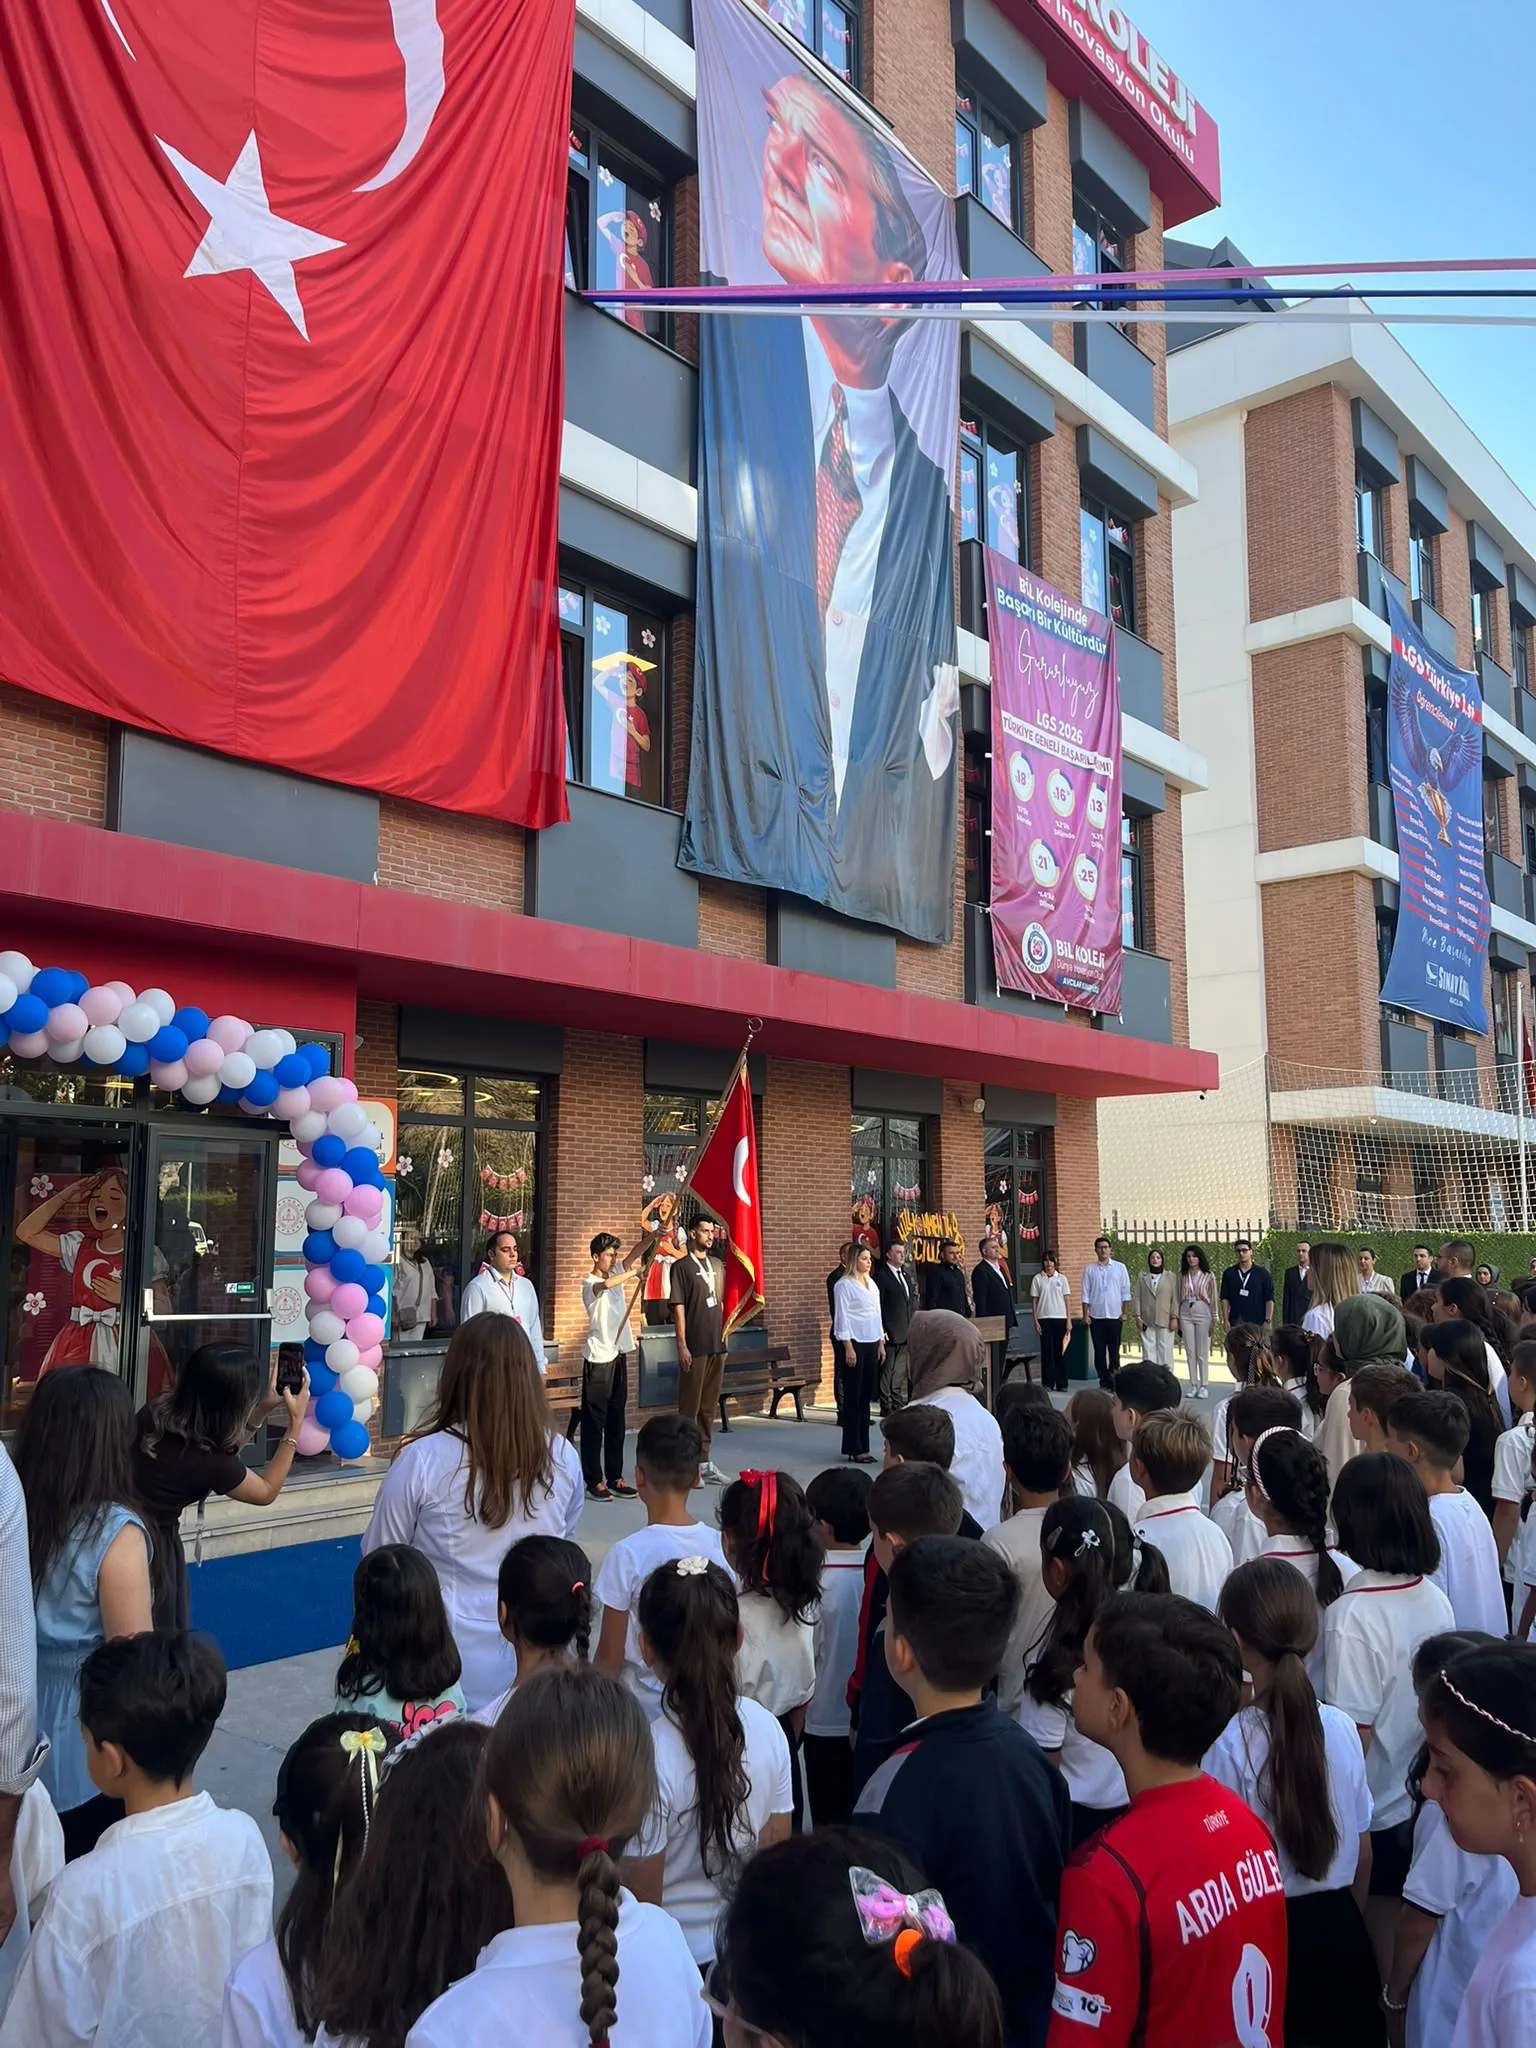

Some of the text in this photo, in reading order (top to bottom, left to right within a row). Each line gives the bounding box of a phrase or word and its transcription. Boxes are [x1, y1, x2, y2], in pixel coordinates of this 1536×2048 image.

[1071, 0, 1197, 138] OLEJİ
[1150, 103, 1195, 164] Okulu
[997, 588, 1107, 654] Başarı Bir Kültürdür
[1036, 587, 1088, 627] Kolejinde
[1401, 638, 1425, 675] LGS
[1425, 660, 1461, 708] Türkiye
[1002, 716, 1034, 742] TÜRKİYE
[1034, 733, 1060, 753] GENELİ
[1036, 708, 1084, 745] LGS 2026
[1056, 786, 1066, 801] 16
[1093, 799, 1103, 812] 13
[1038, 855, 1048, 870] 21
[1081, 869, 1095, 883] 25
[1203, 1809, 1229, 1833] TÜRKİYE
[1175, 1871, 1238, 1945] ARDA
